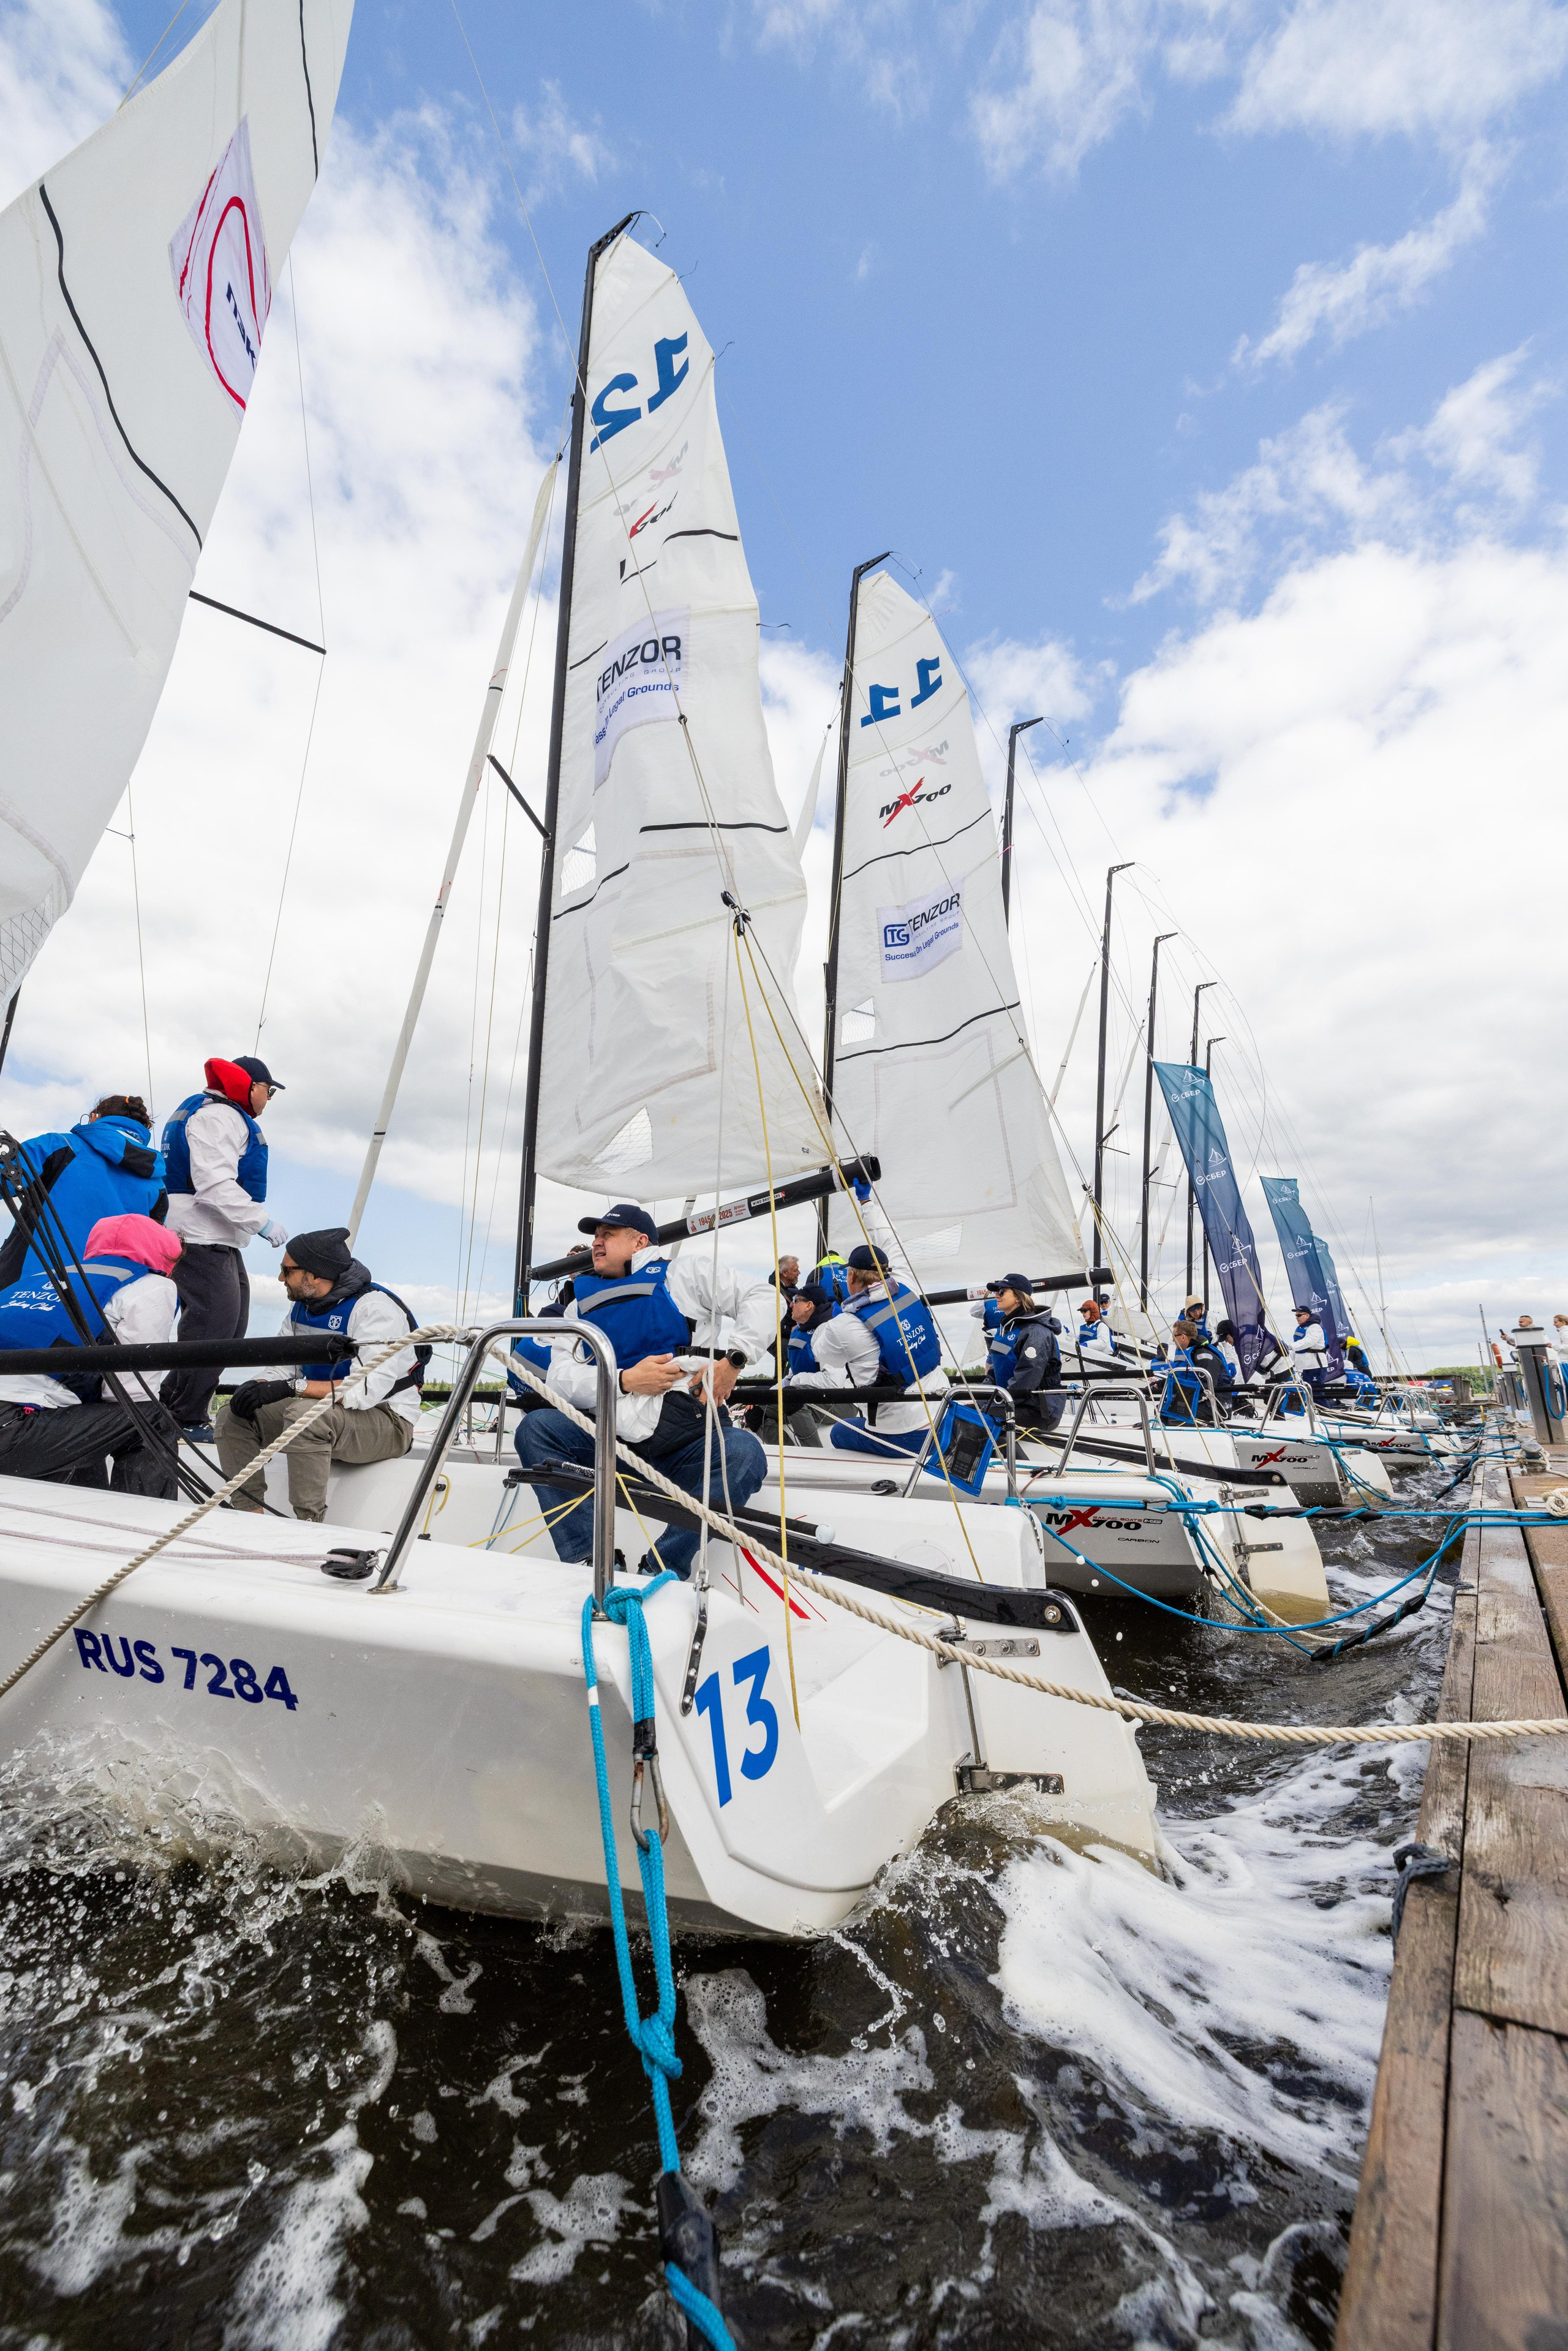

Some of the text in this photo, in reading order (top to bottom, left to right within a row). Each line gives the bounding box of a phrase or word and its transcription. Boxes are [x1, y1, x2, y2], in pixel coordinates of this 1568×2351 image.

[627, 682, 679, 698] Grounds
[879, 776, 951, 829] MX700
[885, 951, 916, 961] Success
[922, 935, 934, 949] Legal
[934, 922, 959, 940] Grounds
[1181, 1089, 1200, 1099] СБЕР
[1206, 1170, 1226, 1181] СБЕР
[698, 1215, 710, 1226] 1945
[719, 1209, 733, 1220] 2025
[10, 1291, 61, 1302] TENZO
[896, 1325, 925, 1346] TNZOR
[1251, 1445, 1308, 1470] MX700
[1046, 1506, 1142, 1536] MX700
[73, 1628, 299, 1711] RUS 7284
[694, 1645, 778, 1808] 13
